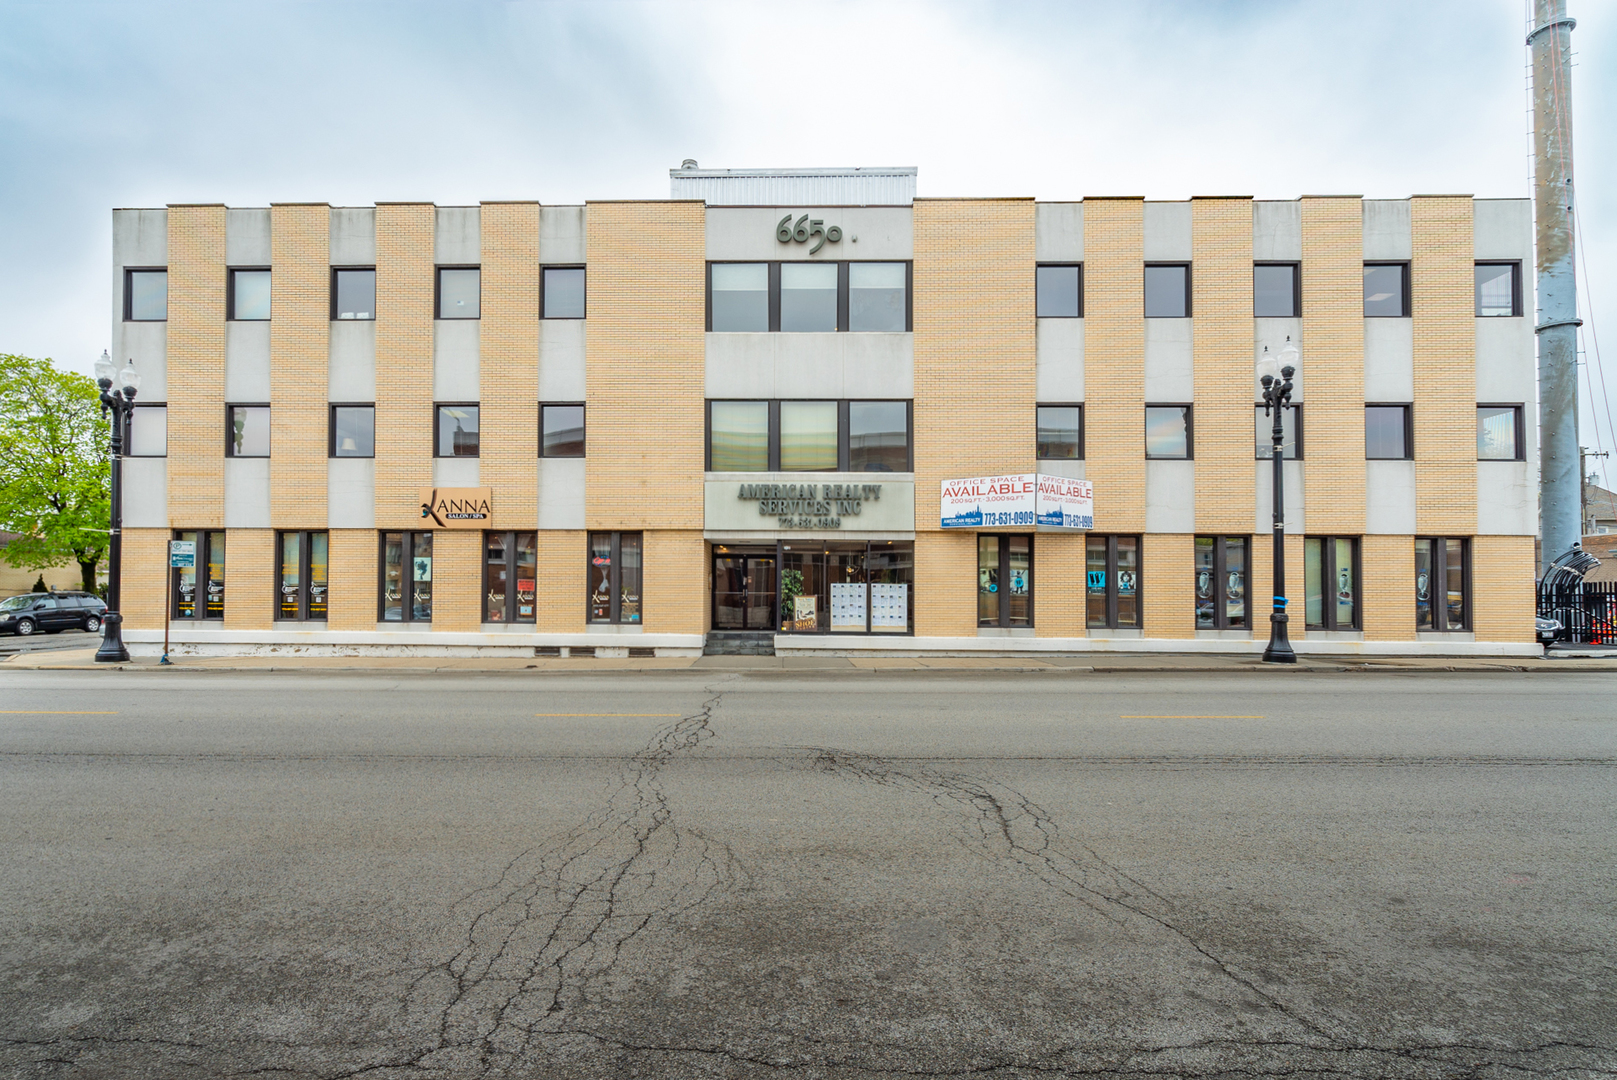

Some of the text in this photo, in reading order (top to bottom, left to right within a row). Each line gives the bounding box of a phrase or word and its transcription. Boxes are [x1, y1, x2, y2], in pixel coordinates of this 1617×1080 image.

[776, 213, 843, 256] 6650
[949, 476, 1025, 487] OFFICE SPACE
[1042, 476, 1087, 487] OFFICE SPACE
[738, 484, 882, 500] AMERICAN REALTY
[942, 482, 1034, 498] AVAILABLE
[1038, 482, 1092, 499] AVAILABLE
[421, 488, 491, 528] KANNA
[759, 499, 862, 516] SERVICES INC
[984, 511, 1034, 525] 773-631-0909
[1064, 513, 1093, 528] 773-631-0909
